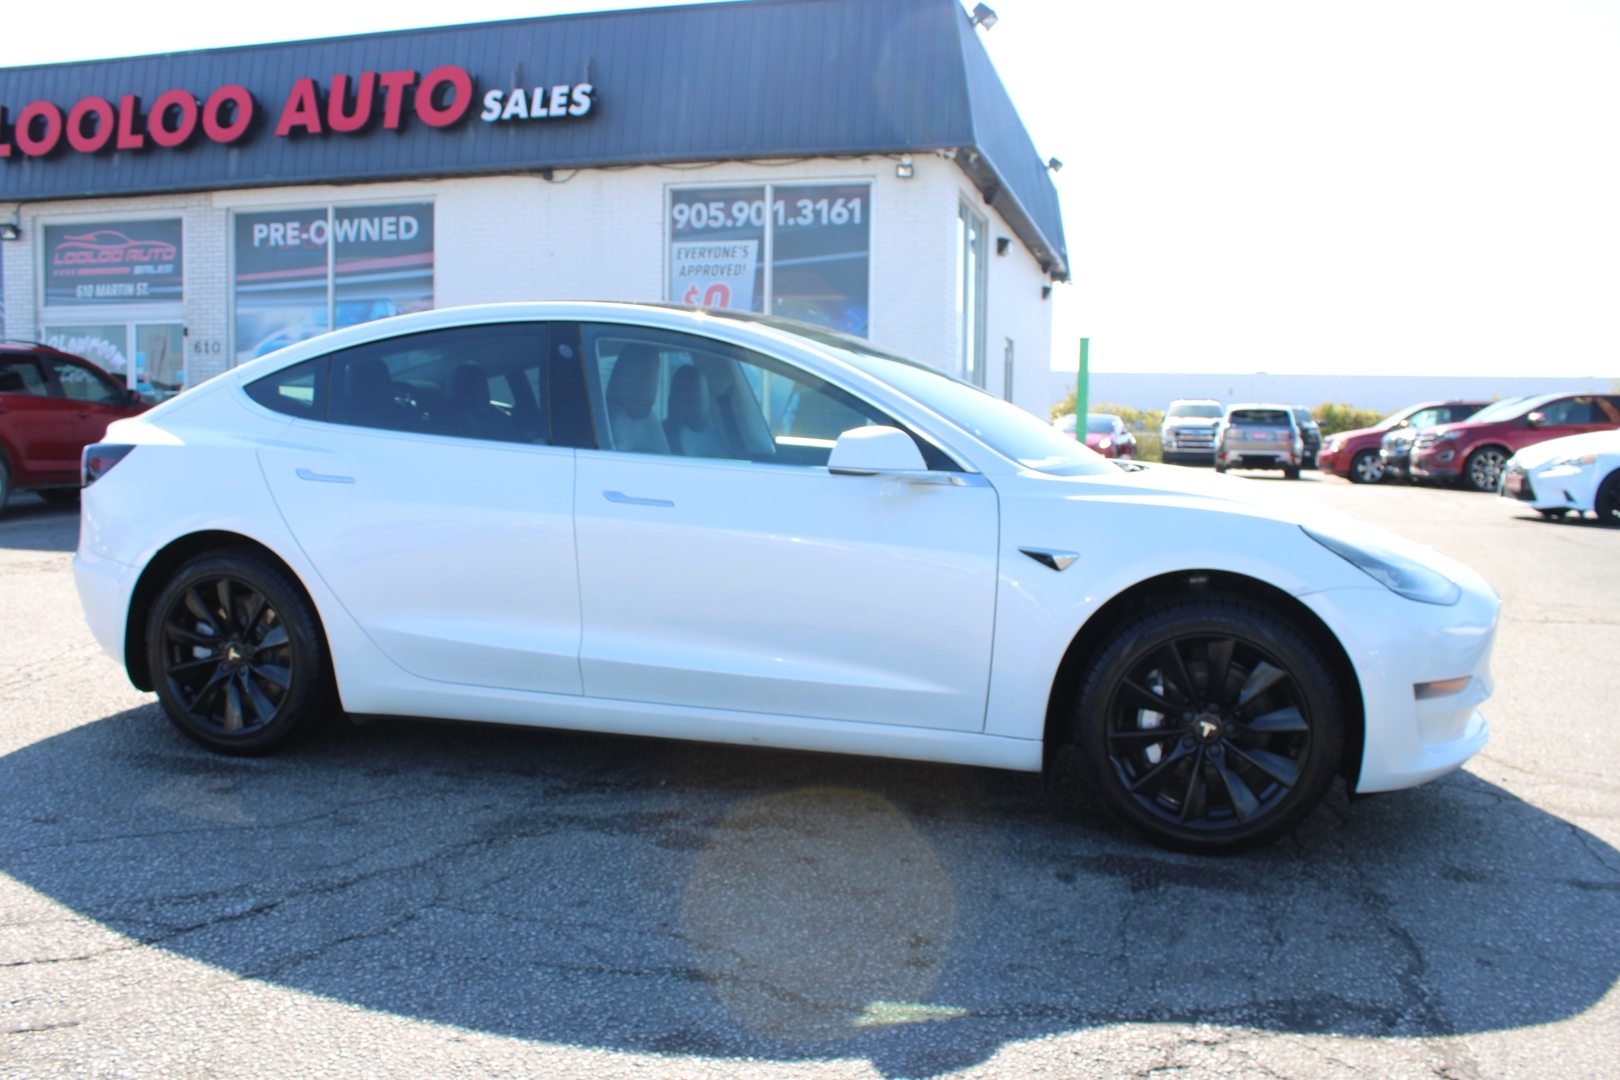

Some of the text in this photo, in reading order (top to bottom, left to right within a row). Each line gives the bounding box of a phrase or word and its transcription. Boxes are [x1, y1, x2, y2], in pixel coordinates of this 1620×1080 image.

[275, 65, 472, 137] AUTO
[480, 82, 594, 123] SALES
[672, 197, 862, 230] 905.901.3161
[253, 215, 419, 248] PRE-OWNED
[53, 247, 177, 265] LOOLOO AUTO
[676, 245, 750, 260] EVERYONE'S
[679, 264, 747, 278] APPROVED!
[95, 283, 135, 297] MARTIN
[193, 341, 222, 354] 610
